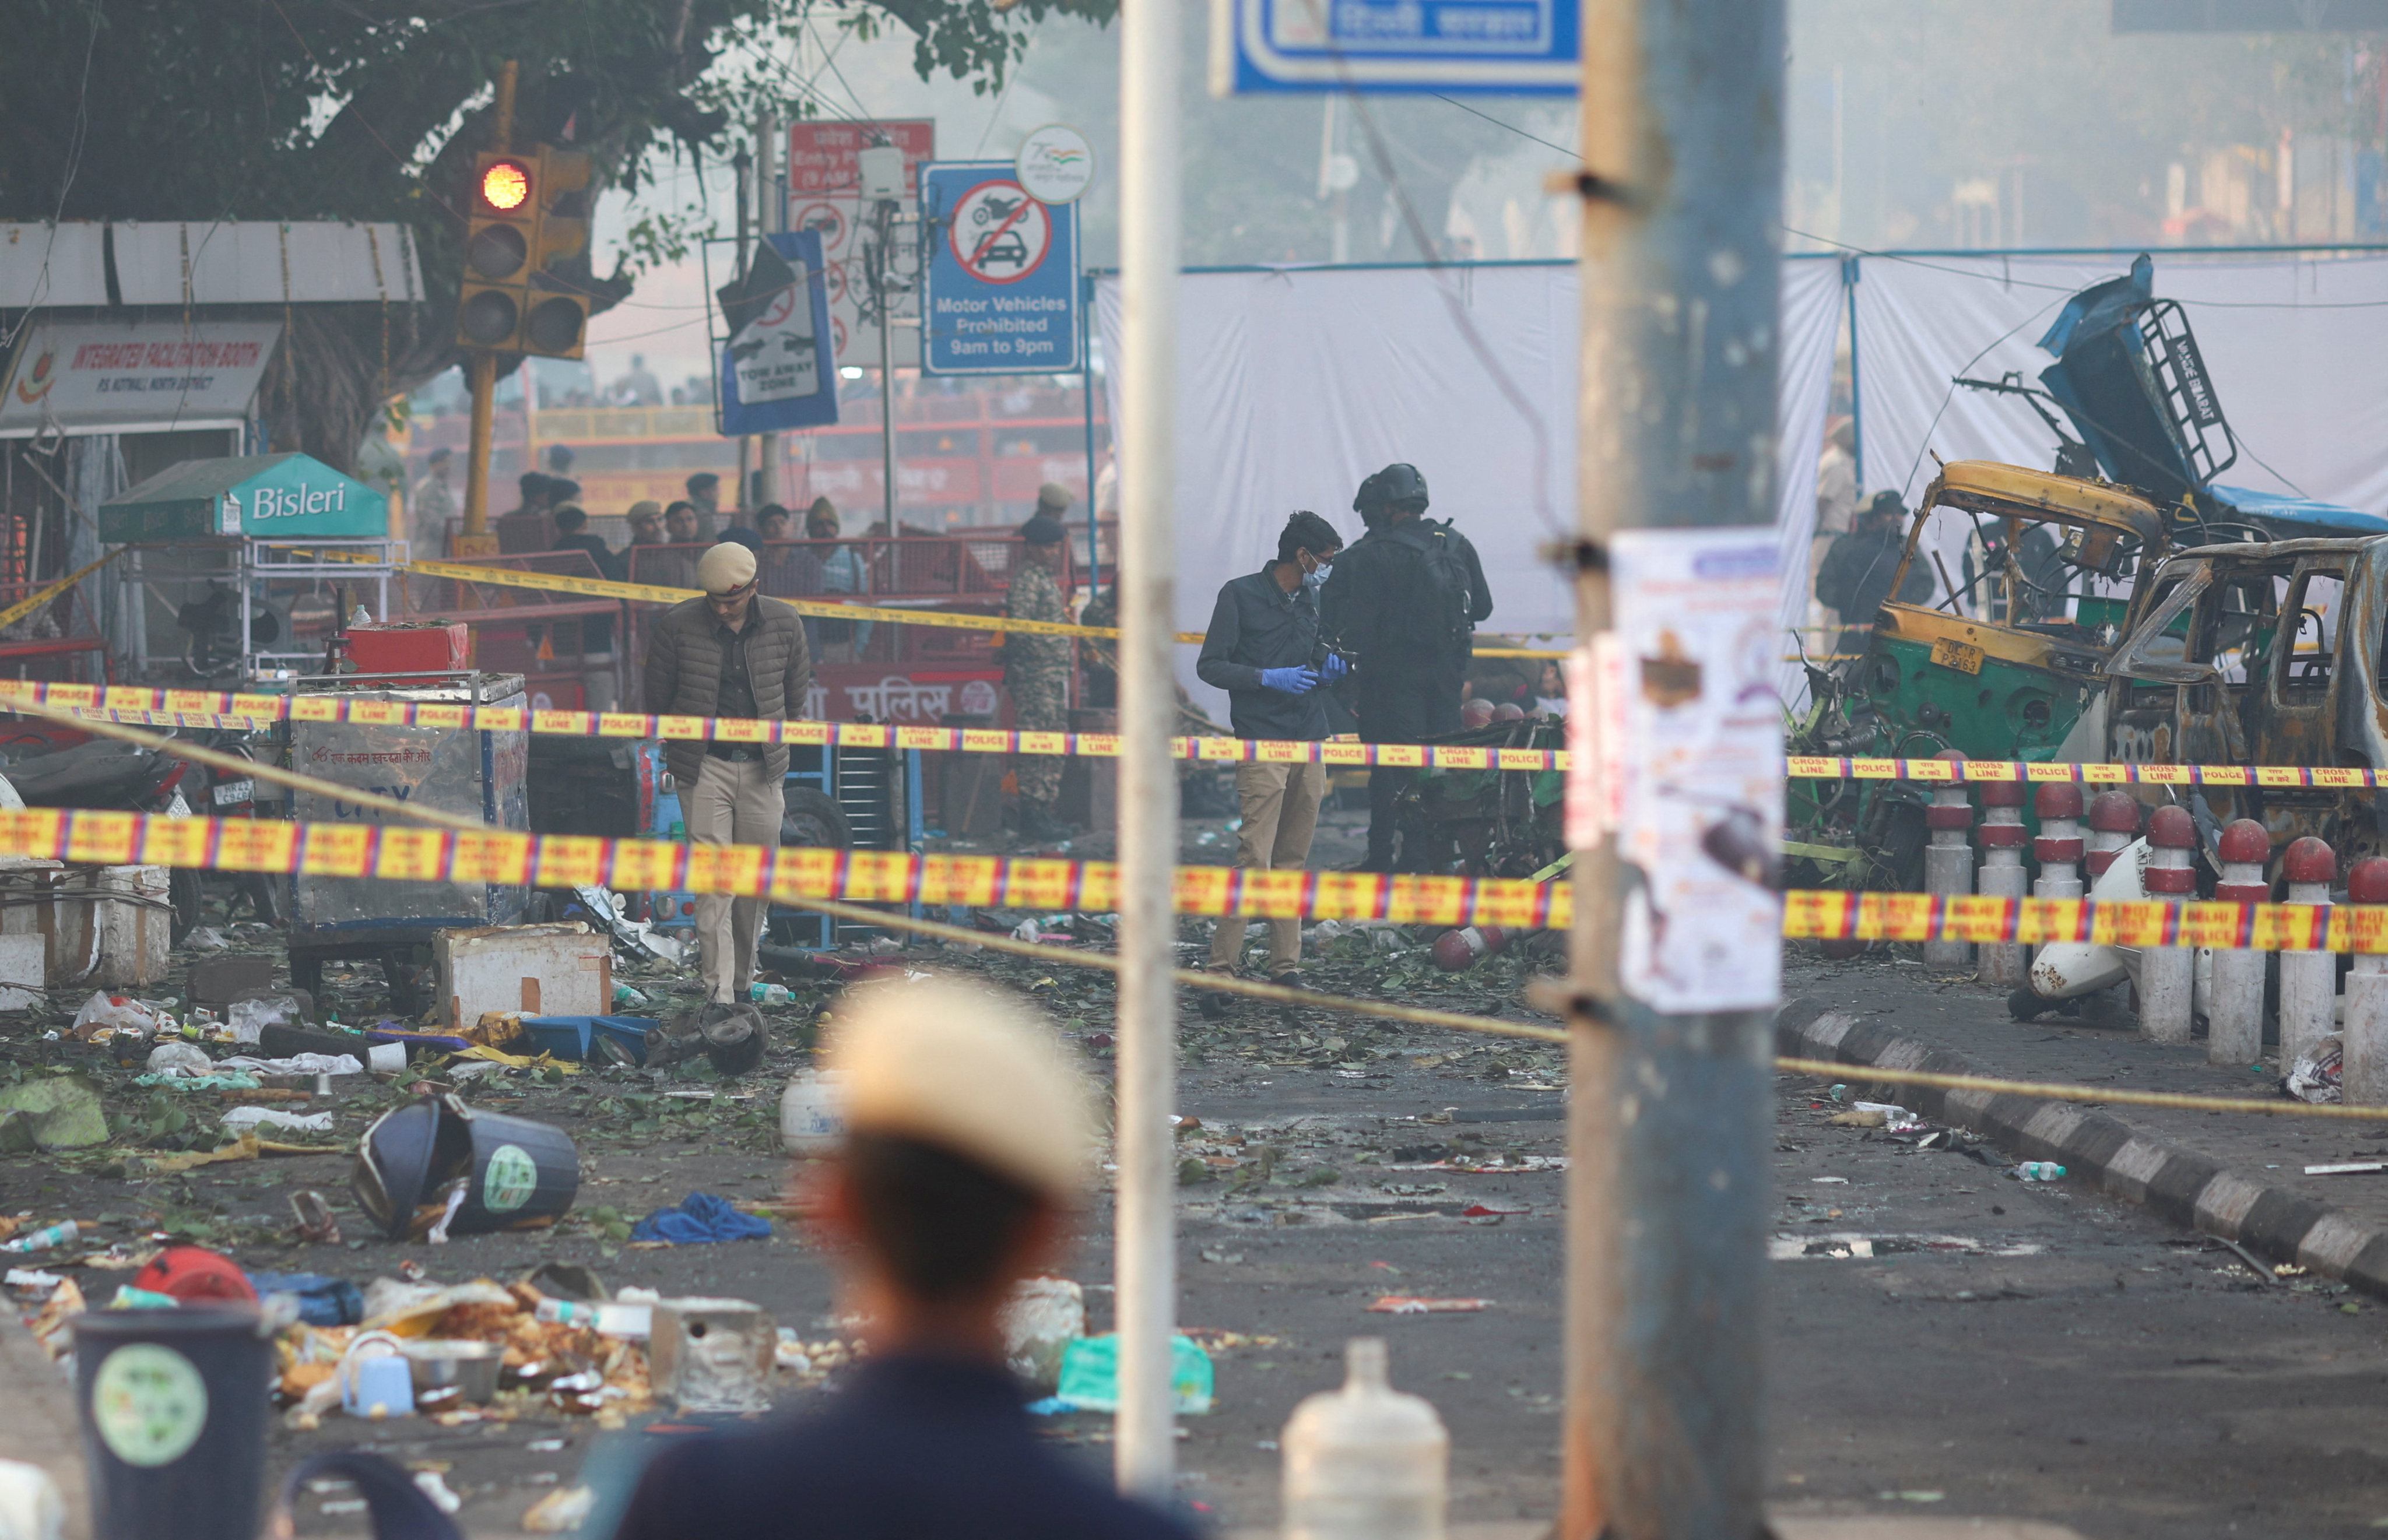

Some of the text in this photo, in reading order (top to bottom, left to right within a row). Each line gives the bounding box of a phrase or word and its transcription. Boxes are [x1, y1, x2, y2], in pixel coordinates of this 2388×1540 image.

[936, 296, 1067, 313] Motor Vehicles
[956, 317, 1048, 333] Prohibited
[950, 338, 1053, 357] 9am to 9pm
[71, 343, 147, 370] INTEGRATED
[740, 361, 812, 381] TOW AWAY
[759, 377, 796, 391] ZONE
[253, 482, 345, 519] Bisleri
[50, 690, 89, 700] POLICE
[236, 700, 275, 711] POLICE
[420, 710, 458, 720] POLICE
[603, 719, 642, 730] POLICE
[785, 727, 824, 738] POLICE
[902, 726, 939, 735] CROSS
[965, 736, 1004, 744] POLICE
[1083, 734, 1118, 743] CROSS
[1262, 740, 1297, 748] CROSS
[1090, 744, 1113, 752] LINE
[1324, 749, 1362, 758] POLICE
[1501, 755, 1540, 764] POLICE
[1968, 761, 2003, 769] CROSS
[1855, 765, 1894, 773] POLICE
[2181, 929, 2231, 942] POLICE
[2335, 924, 2382, 936] CROSS
